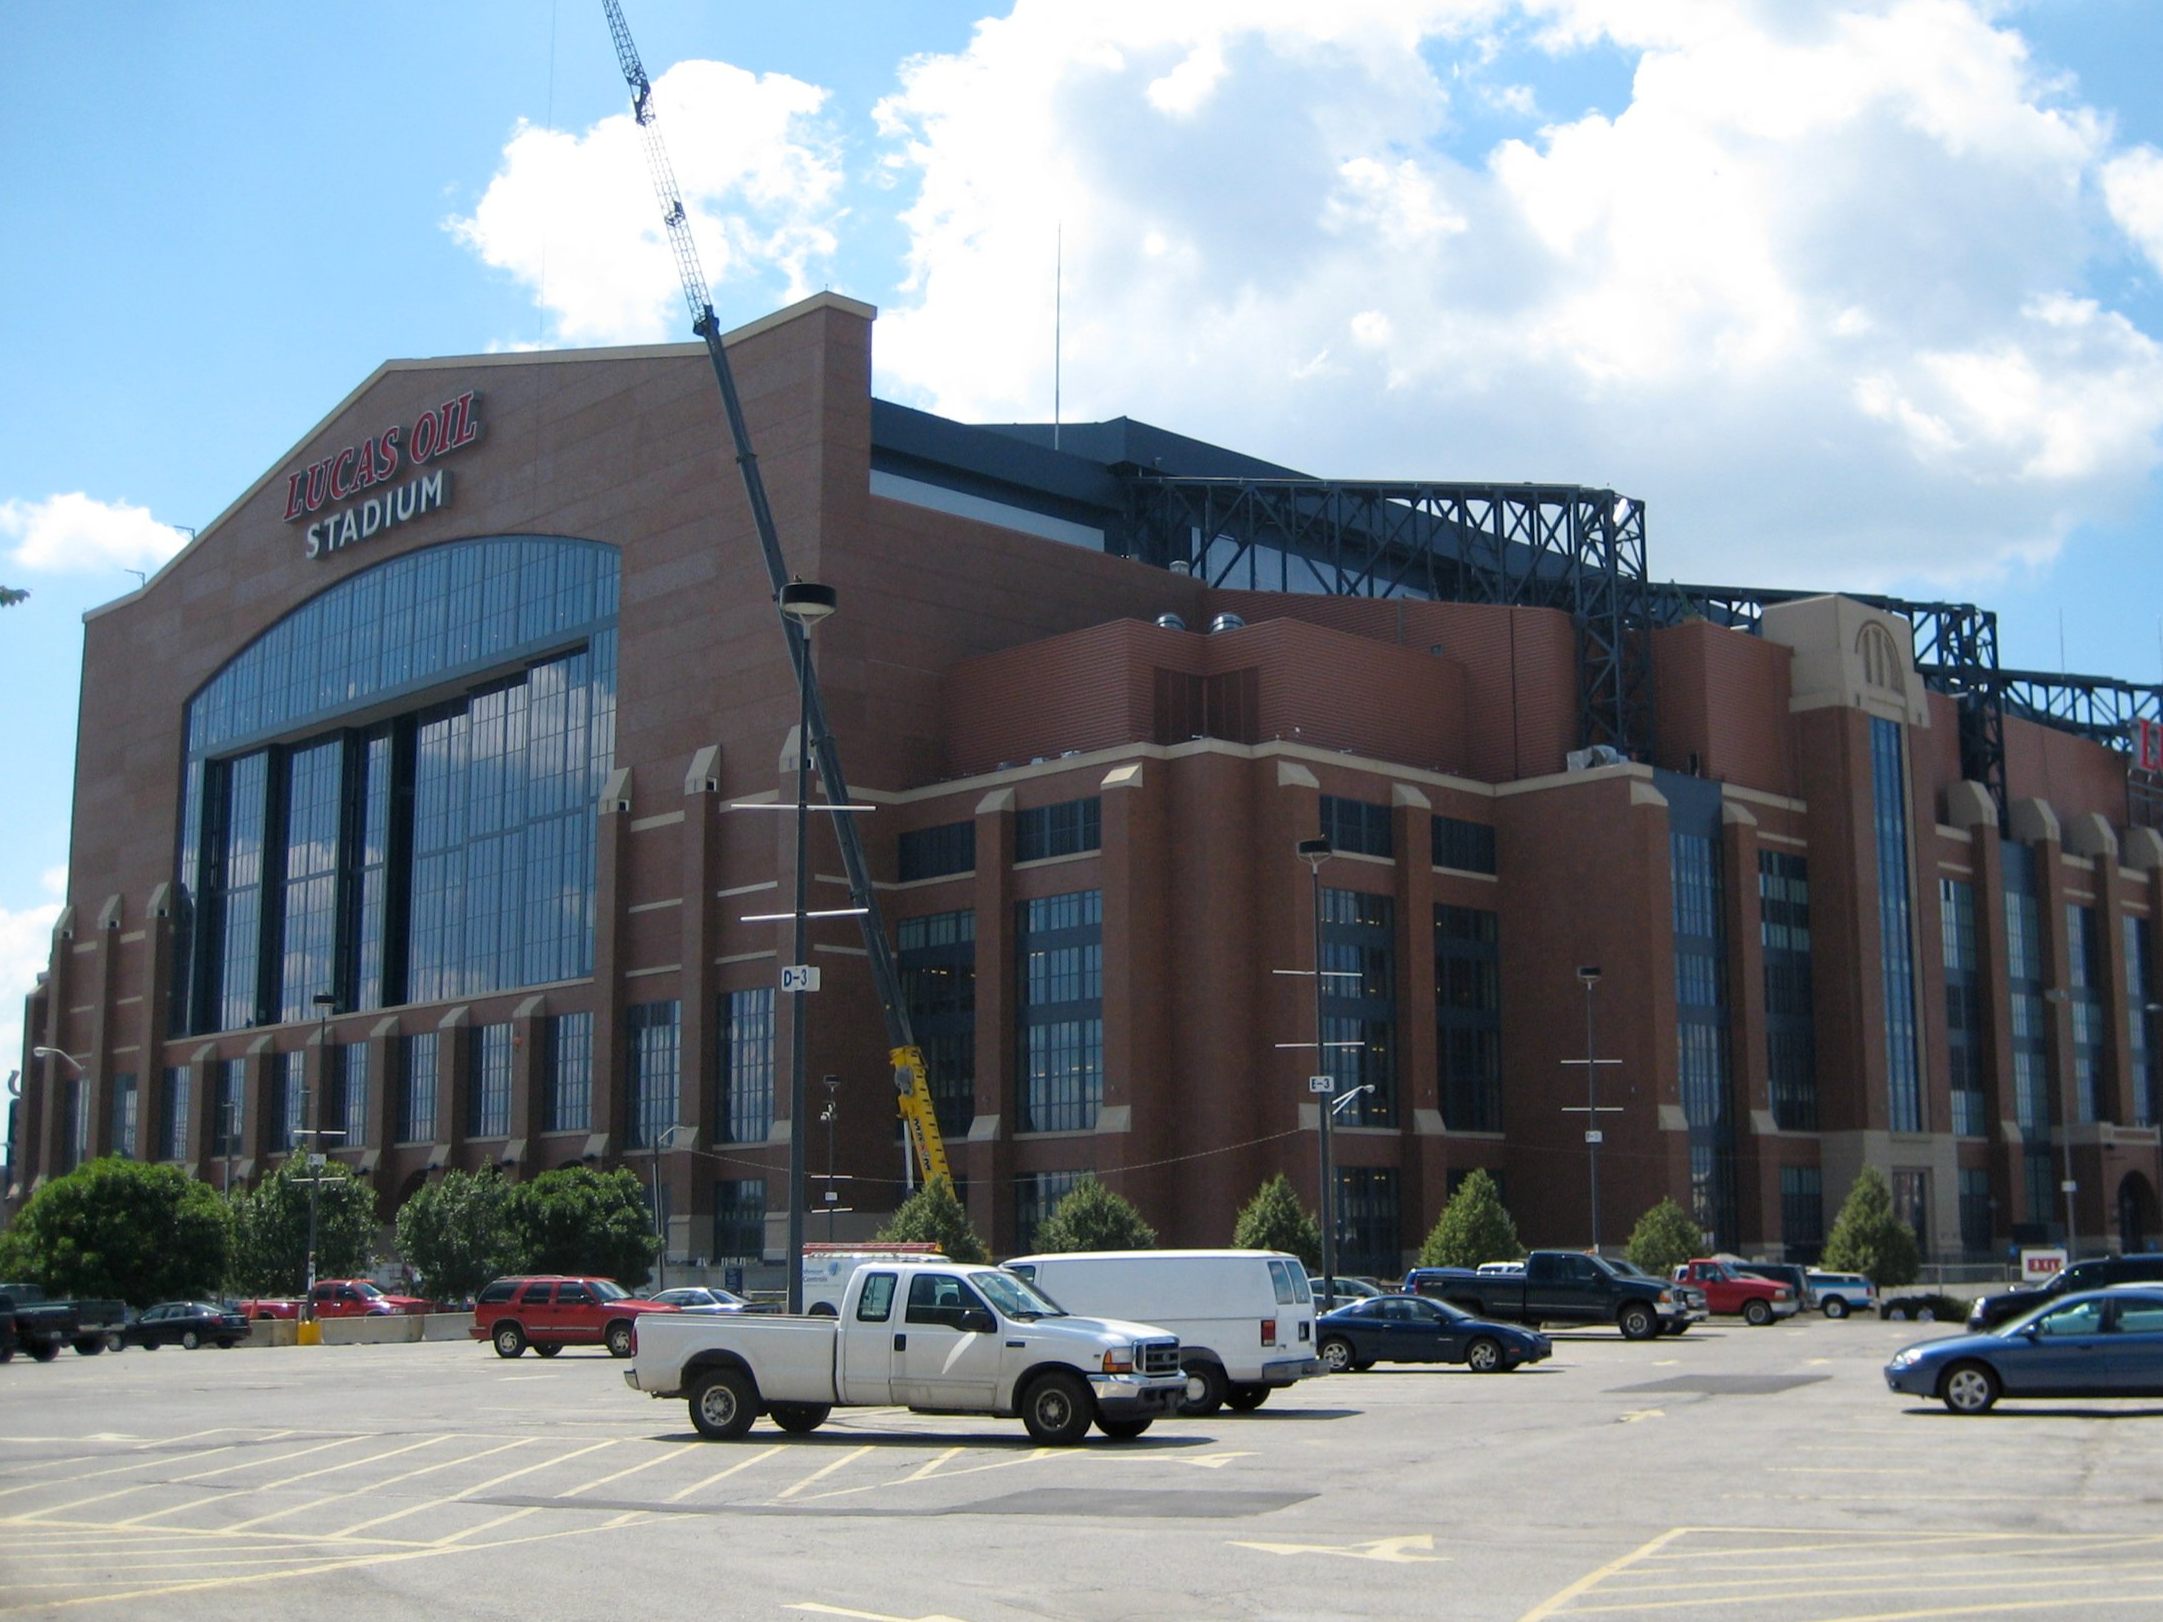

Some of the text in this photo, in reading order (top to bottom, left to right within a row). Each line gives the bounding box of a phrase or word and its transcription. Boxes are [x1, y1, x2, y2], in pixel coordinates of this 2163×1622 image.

[283, 390, 477, 522] LUCAS OIL
[306, 468, 444, 560] STADIUM
[783, 968, 808, 988] D-3
[1311, 1077, 1330, 1090] E-3
[2027, 1257, 2061, 1273] EXIT
